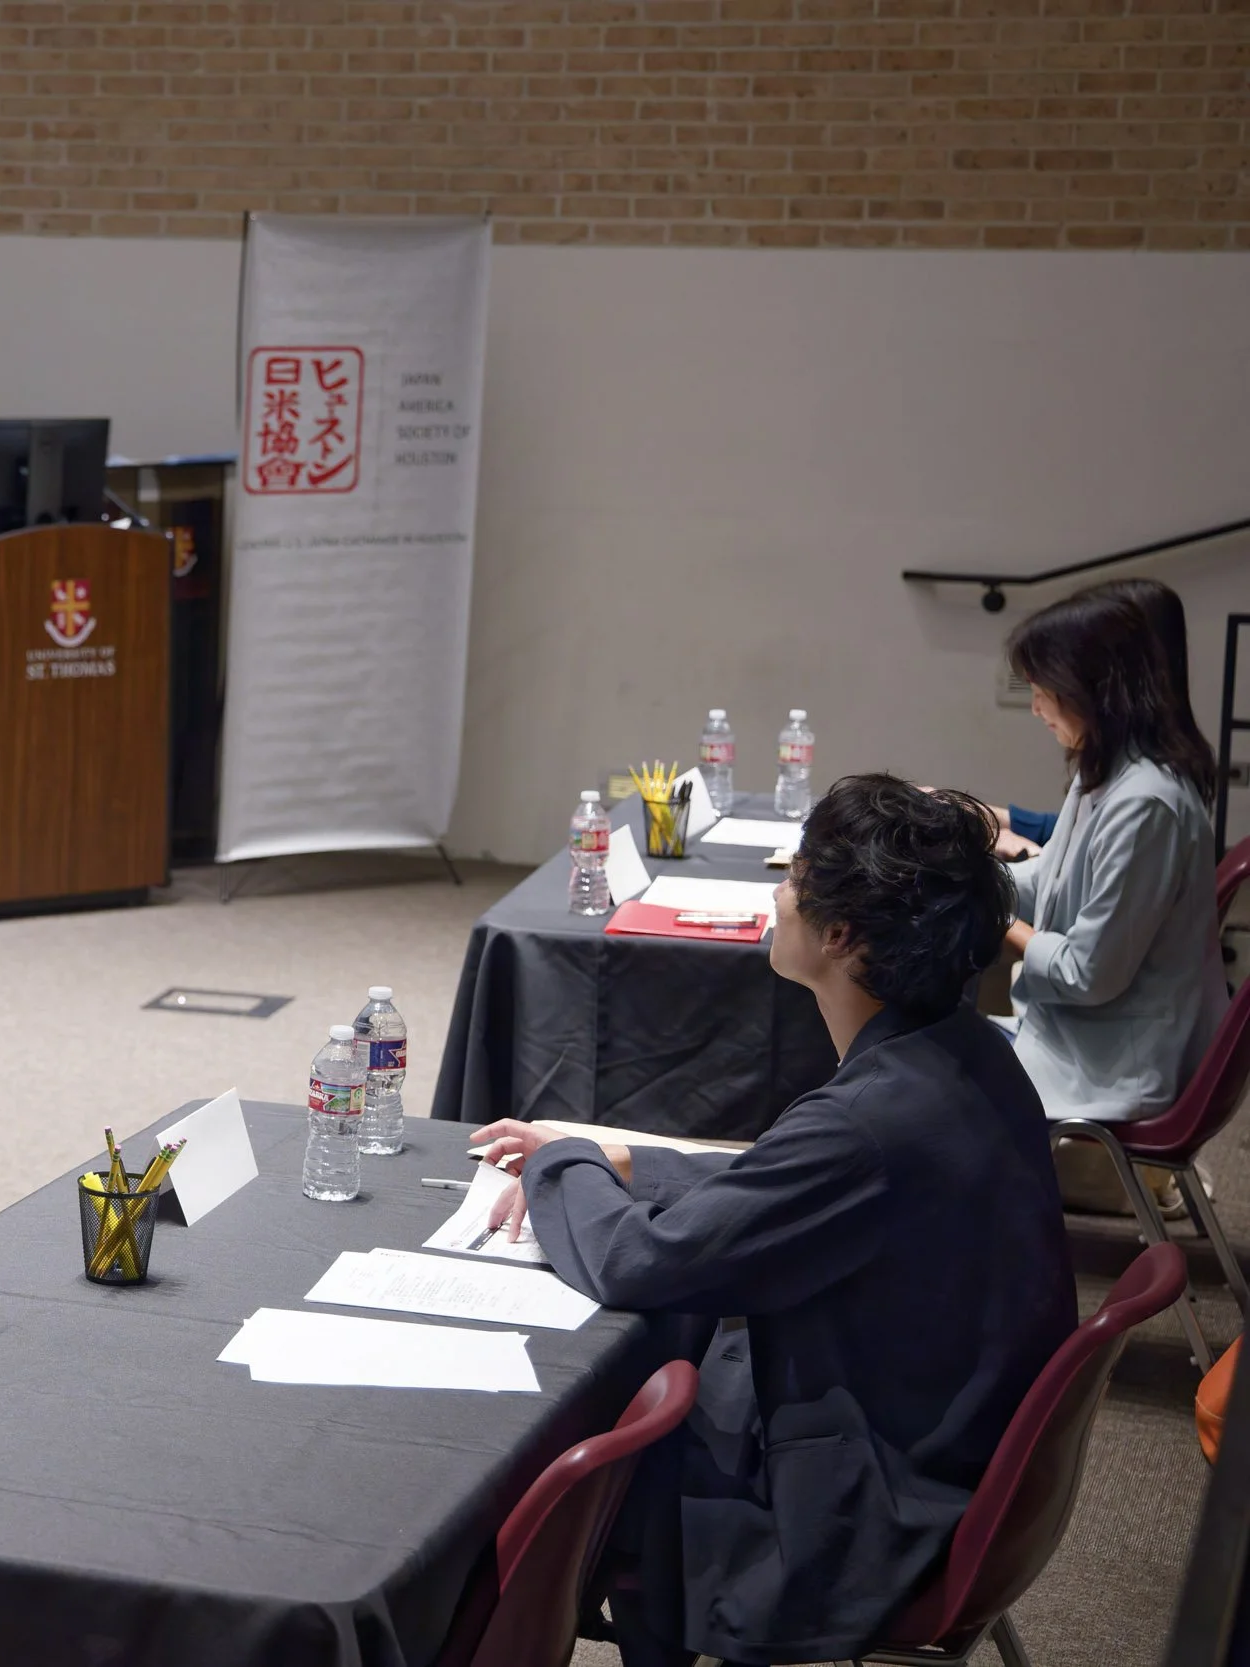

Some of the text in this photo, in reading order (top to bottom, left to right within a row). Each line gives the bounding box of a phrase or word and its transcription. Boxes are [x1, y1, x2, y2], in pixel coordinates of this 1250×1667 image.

[402, 372, 441, 387] JAPAN
[398, 398, 455, 413] AMERICA
[308, 358, 354, 488] ヒューストン
[396, 424, 471, 440] SOCIETY OF
[395, 451, 458, 466] HOUSTON
[26, 646, 115, 660] UNIVERSITY OF
[51, 661, 116, 677] THOMAS
